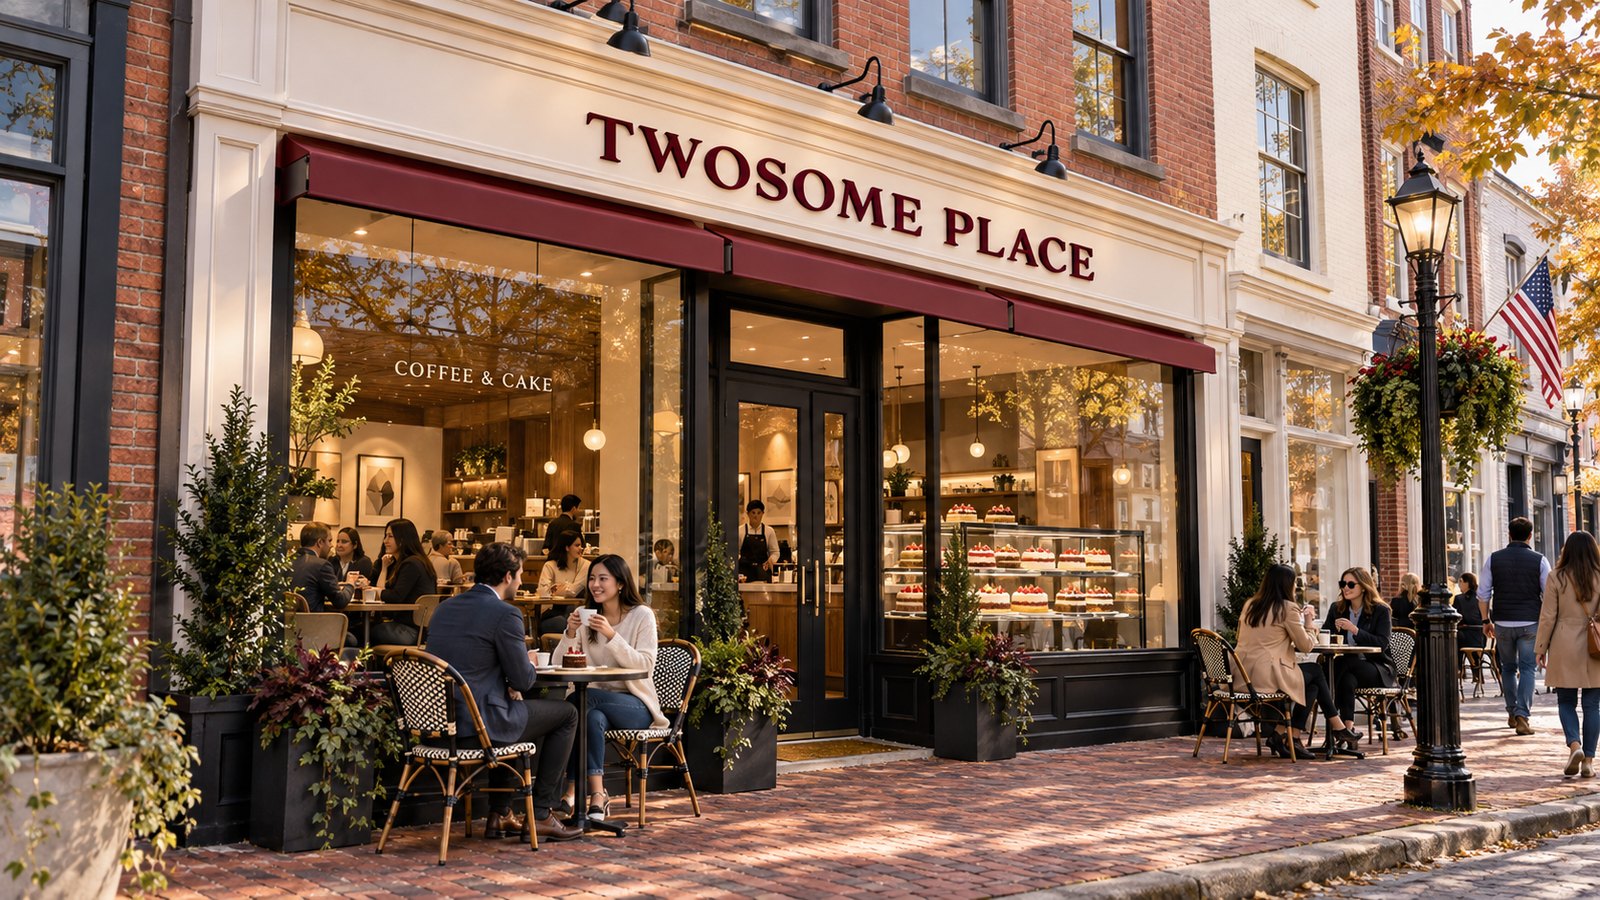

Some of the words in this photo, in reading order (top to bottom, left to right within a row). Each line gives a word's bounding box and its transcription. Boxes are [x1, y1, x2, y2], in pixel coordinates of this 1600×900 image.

[586, 111, 923, 238] TWOSOME
[943, 207, 1095, 282] PLACE
[395, 360, 474, 384] COFFEE
[481, 370, 495, 386] &
[502, 372, 553, 392] CAKE
